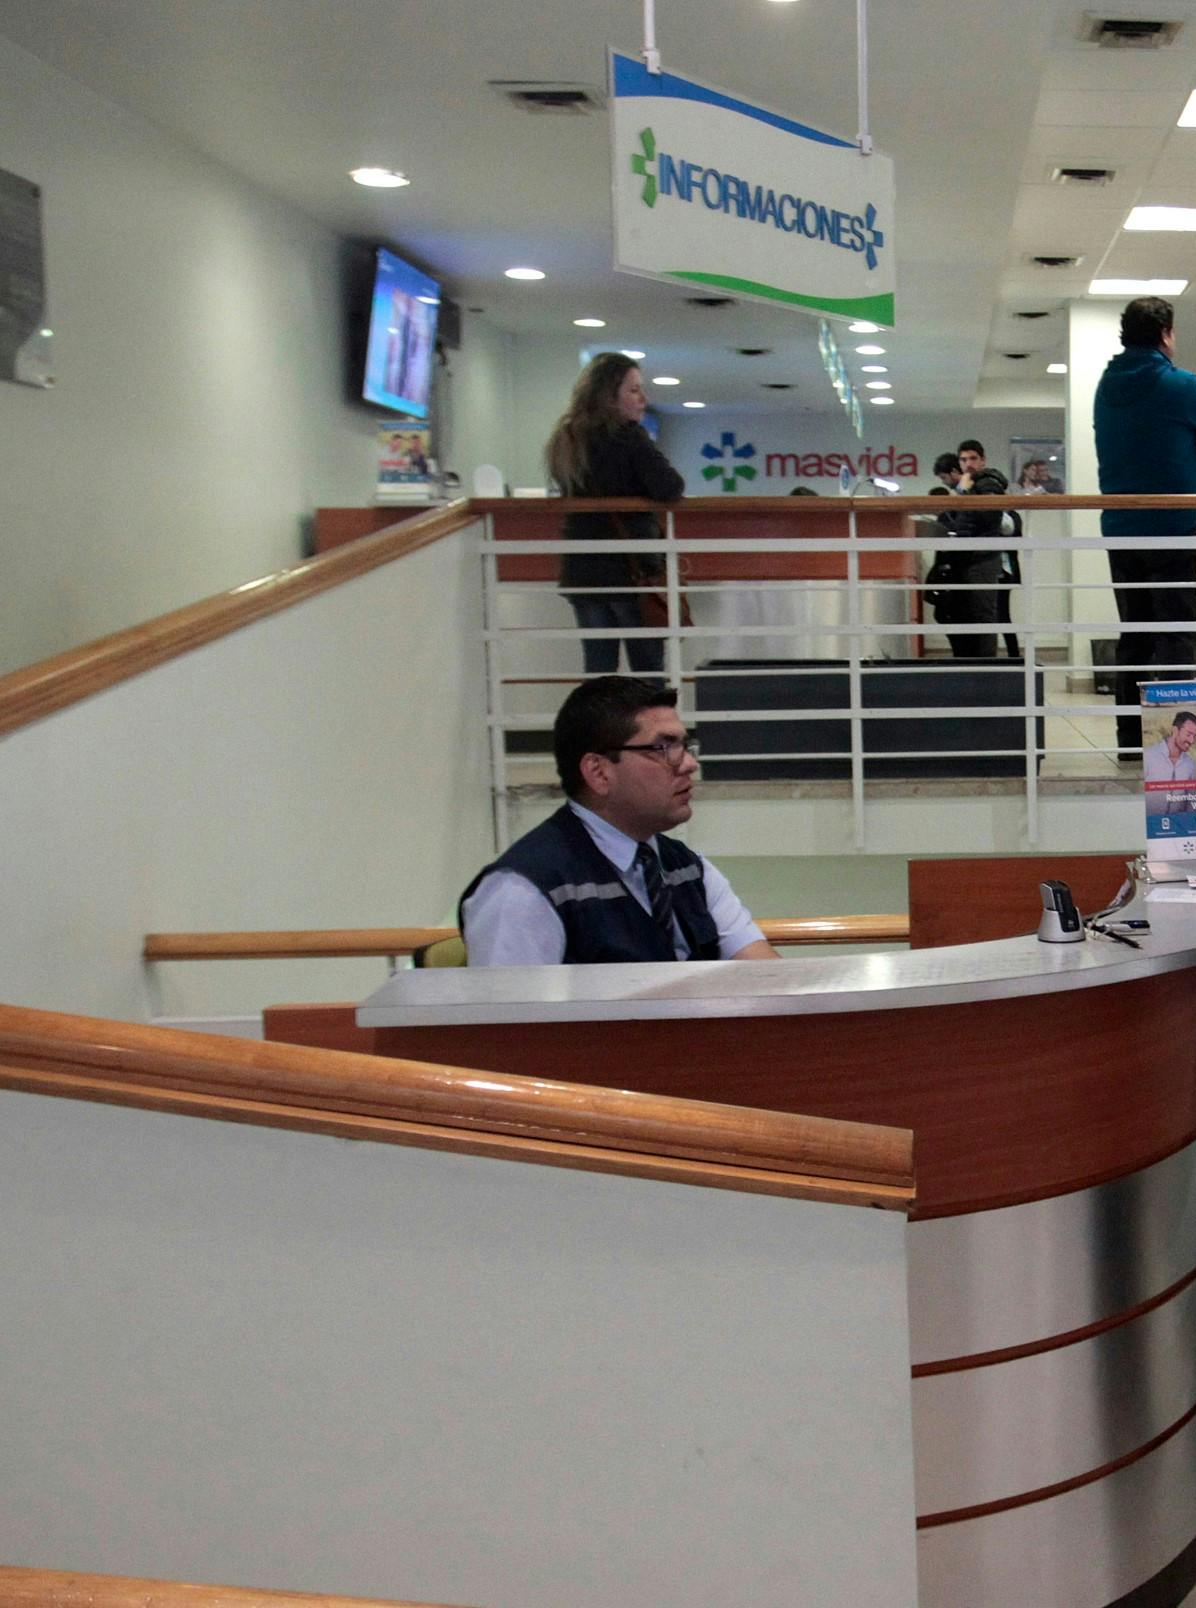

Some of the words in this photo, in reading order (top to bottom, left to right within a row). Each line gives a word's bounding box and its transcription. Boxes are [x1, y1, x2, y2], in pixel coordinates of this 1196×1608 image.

[659, 153, 865, 252] INFORMACIONES
[765, 446, 919, 478] masvida
[1156, 689, 1179, 698] Hazte
[1180, 689, 1190, 697] la
